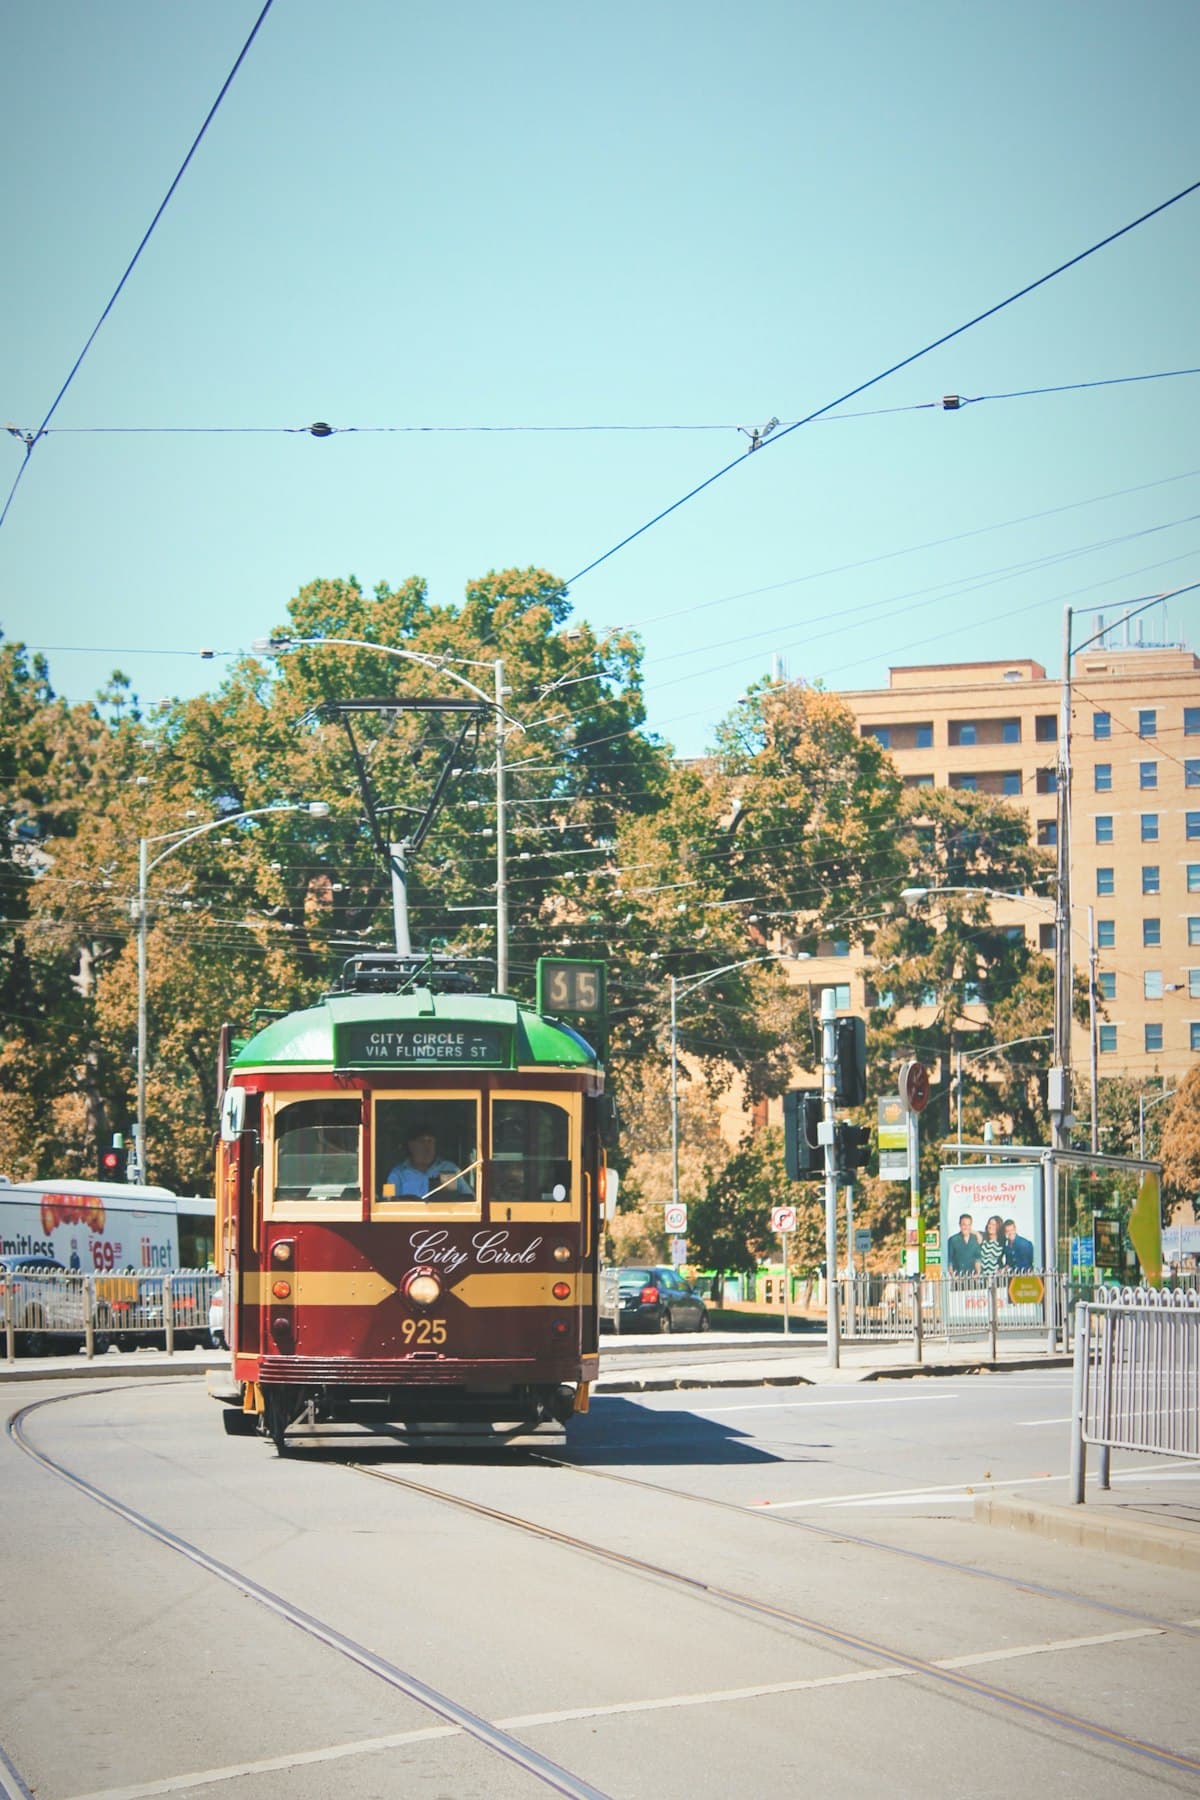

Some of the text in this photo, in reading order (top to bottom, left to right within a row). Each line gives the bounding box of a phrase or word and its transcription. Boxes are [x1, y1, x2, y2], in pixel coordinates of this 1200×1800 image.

[370, 1033, 404, 1044] CITY
[413, 1033, 464, 1044] CIRCLE
[366, 1046, 487, 1057] VIA FLINDERS ST
[953, 1182, 1026, 1193] Chrissie Sam
[973, 1193, 1016, 1203] Browny
[141, 1237, 171, 1268] iinet
[409, 1230, 543, 1274] City Circle
[401, 1319, 447, 1344] 925
